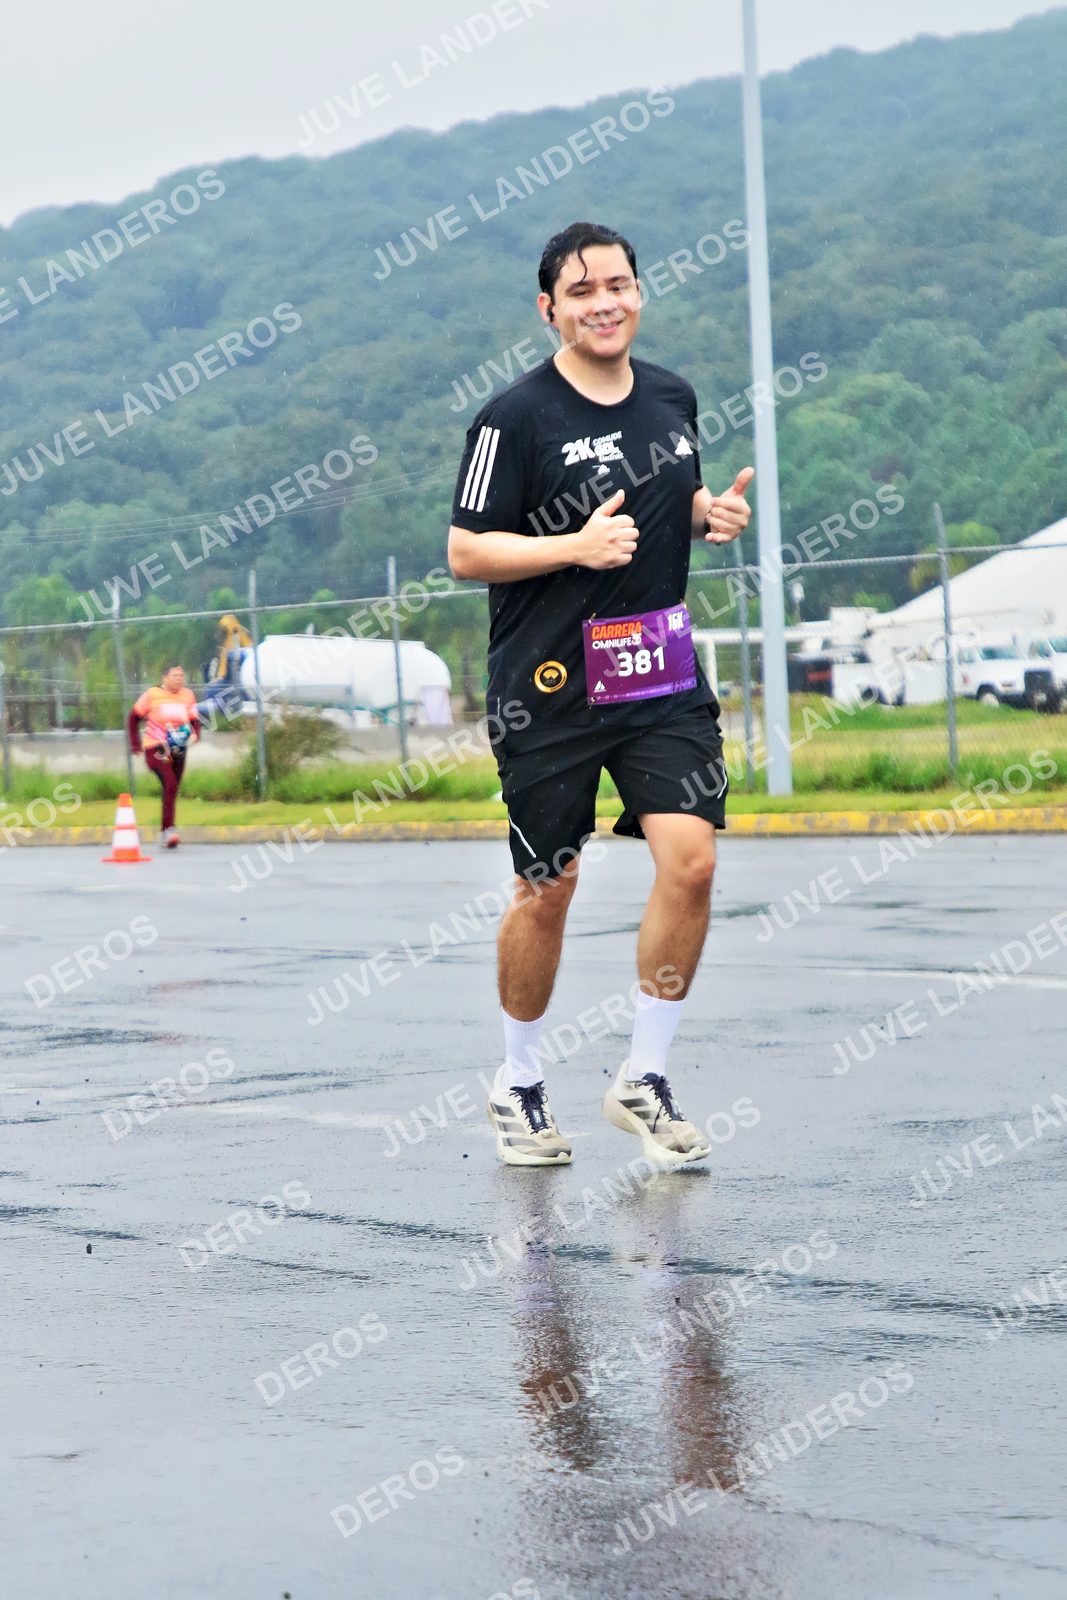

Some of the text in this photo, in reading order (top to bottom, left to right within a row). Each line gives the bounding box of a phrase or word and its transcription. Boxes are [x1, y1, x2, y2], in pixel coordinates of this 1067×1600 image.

[592, 621, 642, 641] CARRERA
[592, 637, 632, 650] OMNILIFE
[617, 646, 666, 677] 381
